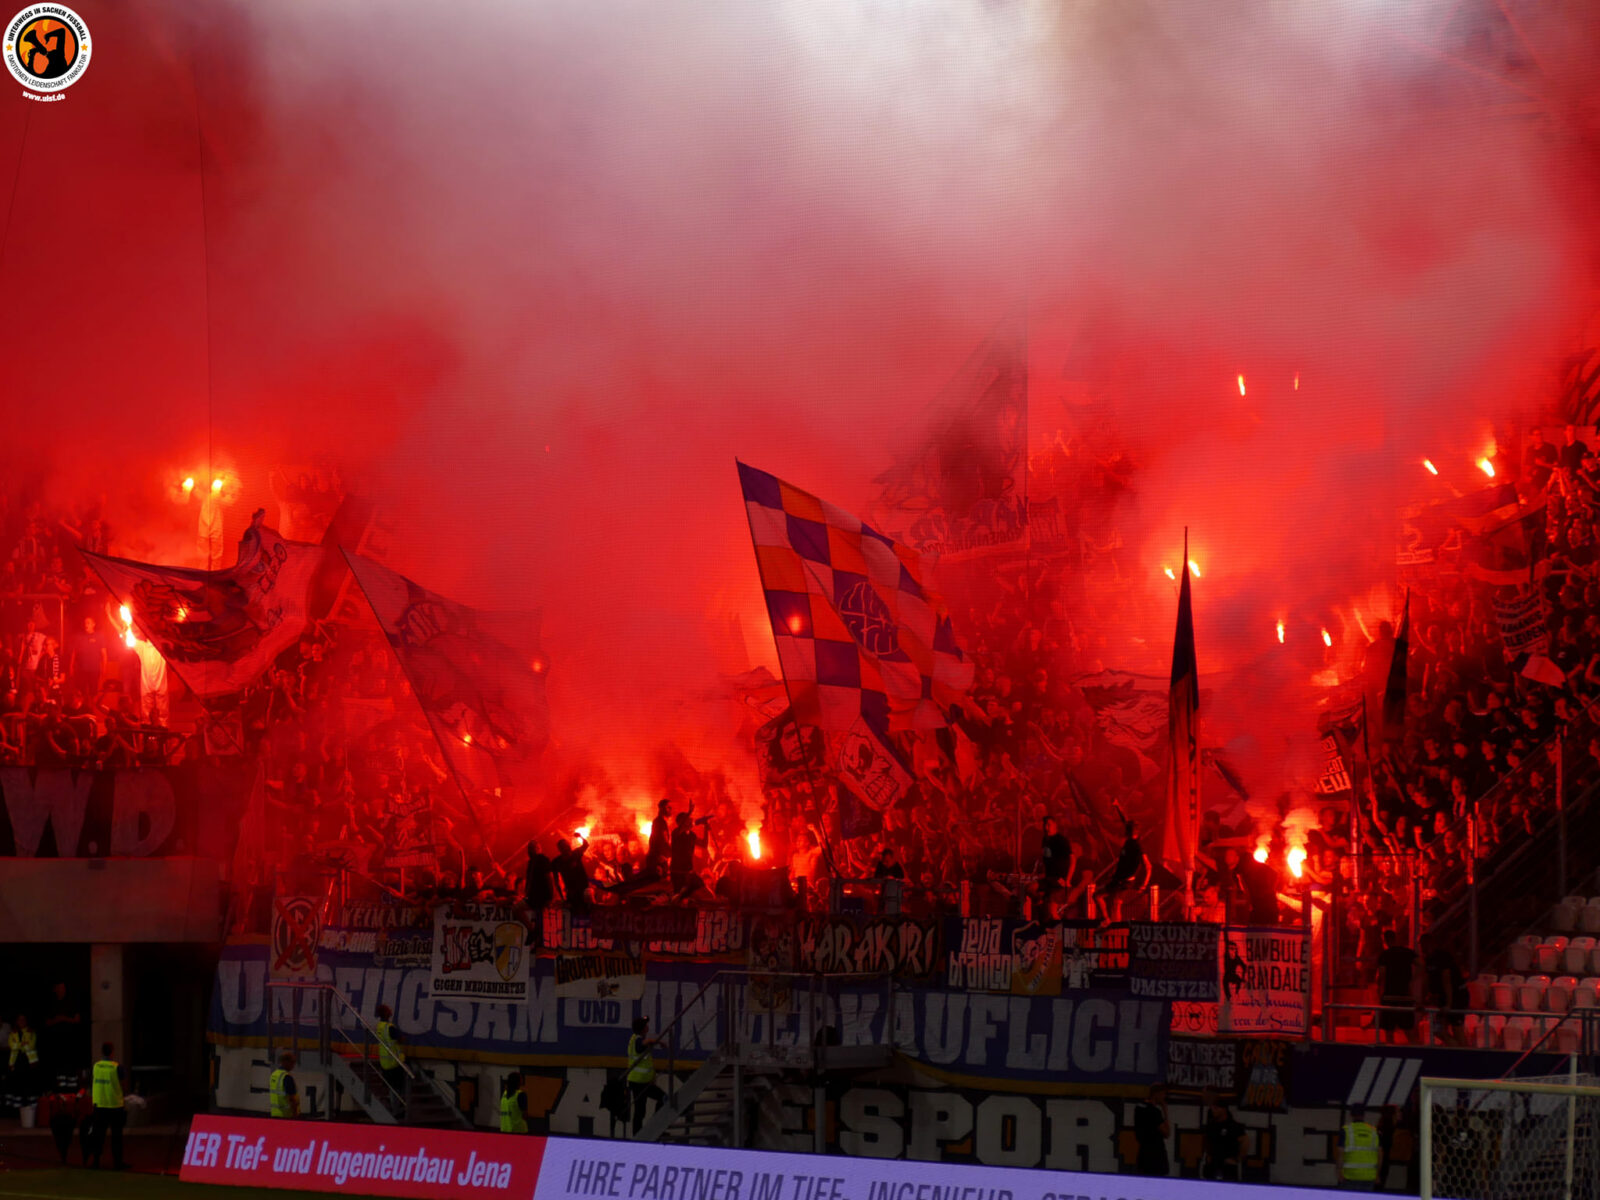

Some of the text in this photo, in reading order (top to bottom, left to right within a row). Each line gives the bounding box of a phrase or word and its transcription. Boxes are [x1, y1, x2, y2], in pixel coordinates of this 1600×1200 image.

[798, 919, 937, 975] HARAKIRI
[464, 980, 526, 994] MEDIENHETZE
[1130, 978, 1218, 998] UMSETZEN
[217, 961, 559, 1042] UNBEUGSAM
[578, 999, 621, 1024] UND
[1168, 1040, 1236, 1065] REFUGEES
[1167, 1064, 1235, 1088] WELCOME
[225, 1134, 268, 1171] Tief-
[273, 1140, 315, 1175] und
[316, 1141, 455, 1185] Ingenieurbau
[458, 1151, 512, 1189] Jena
[566, 1159, 626, 1197] IHRE
[628, 1163, 743, 1200] PARTNER
[749, 1172, 784, 1200] IM
